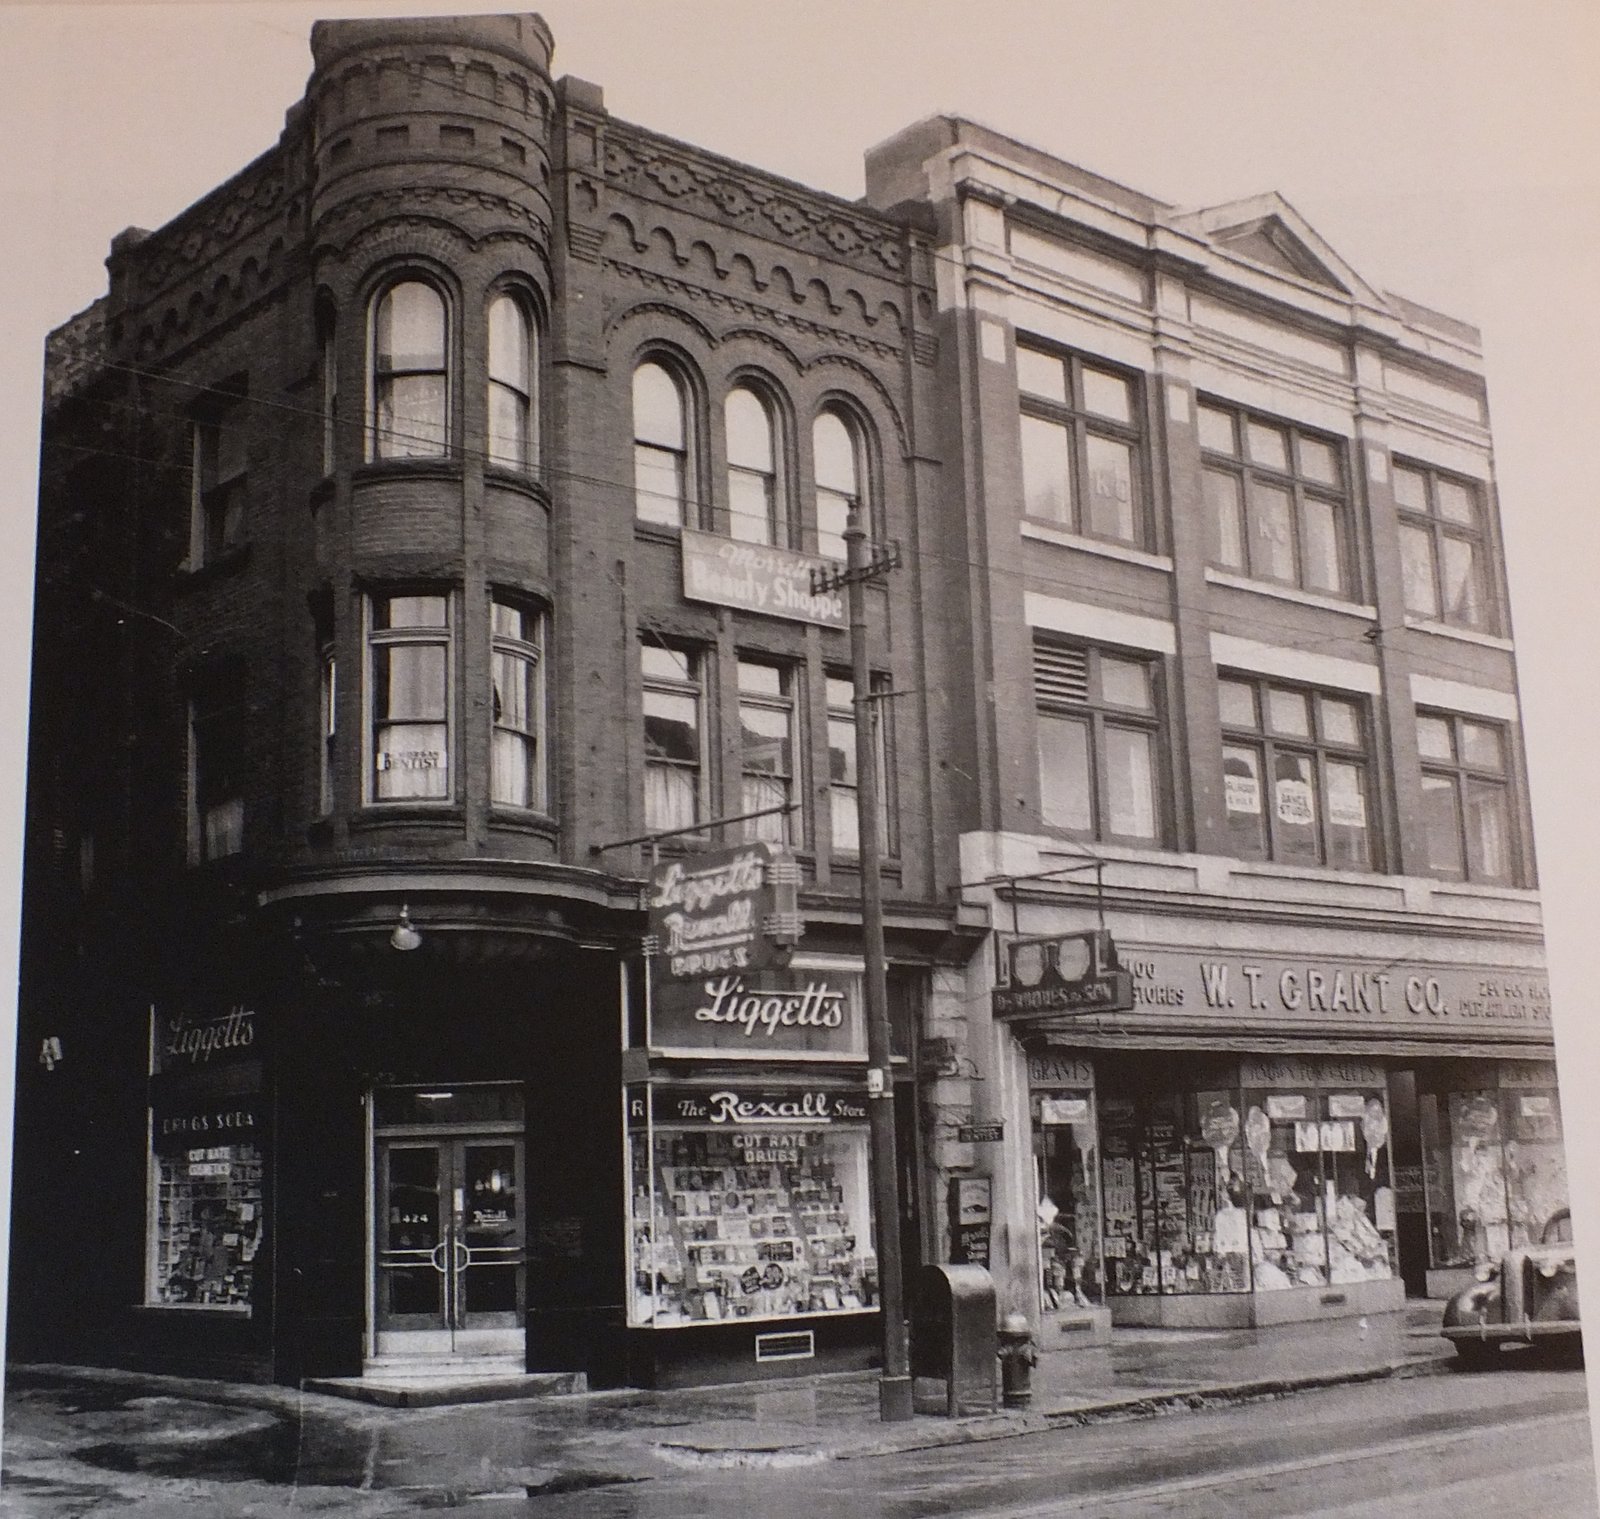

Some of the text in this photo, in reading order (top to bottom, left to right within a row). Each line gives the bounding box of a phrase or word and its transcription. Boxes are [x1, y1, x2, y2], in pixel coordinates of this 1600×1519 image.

[774, 576, 843, 620] Shoppe
[671, 947, 748, 977] DRUGS
[695, 975, 844, 1037] Liggett's
[1200, 962, 1449, 1017] W. T. GRANT CO.
[166, 1004, 256, 1064] Liggett's
[677, 1091, 867, 1123] The Rexall Store
[732, 1134, 808, 1149] CUT RATE
[744, 1149, 799, 1164] DRUGS
